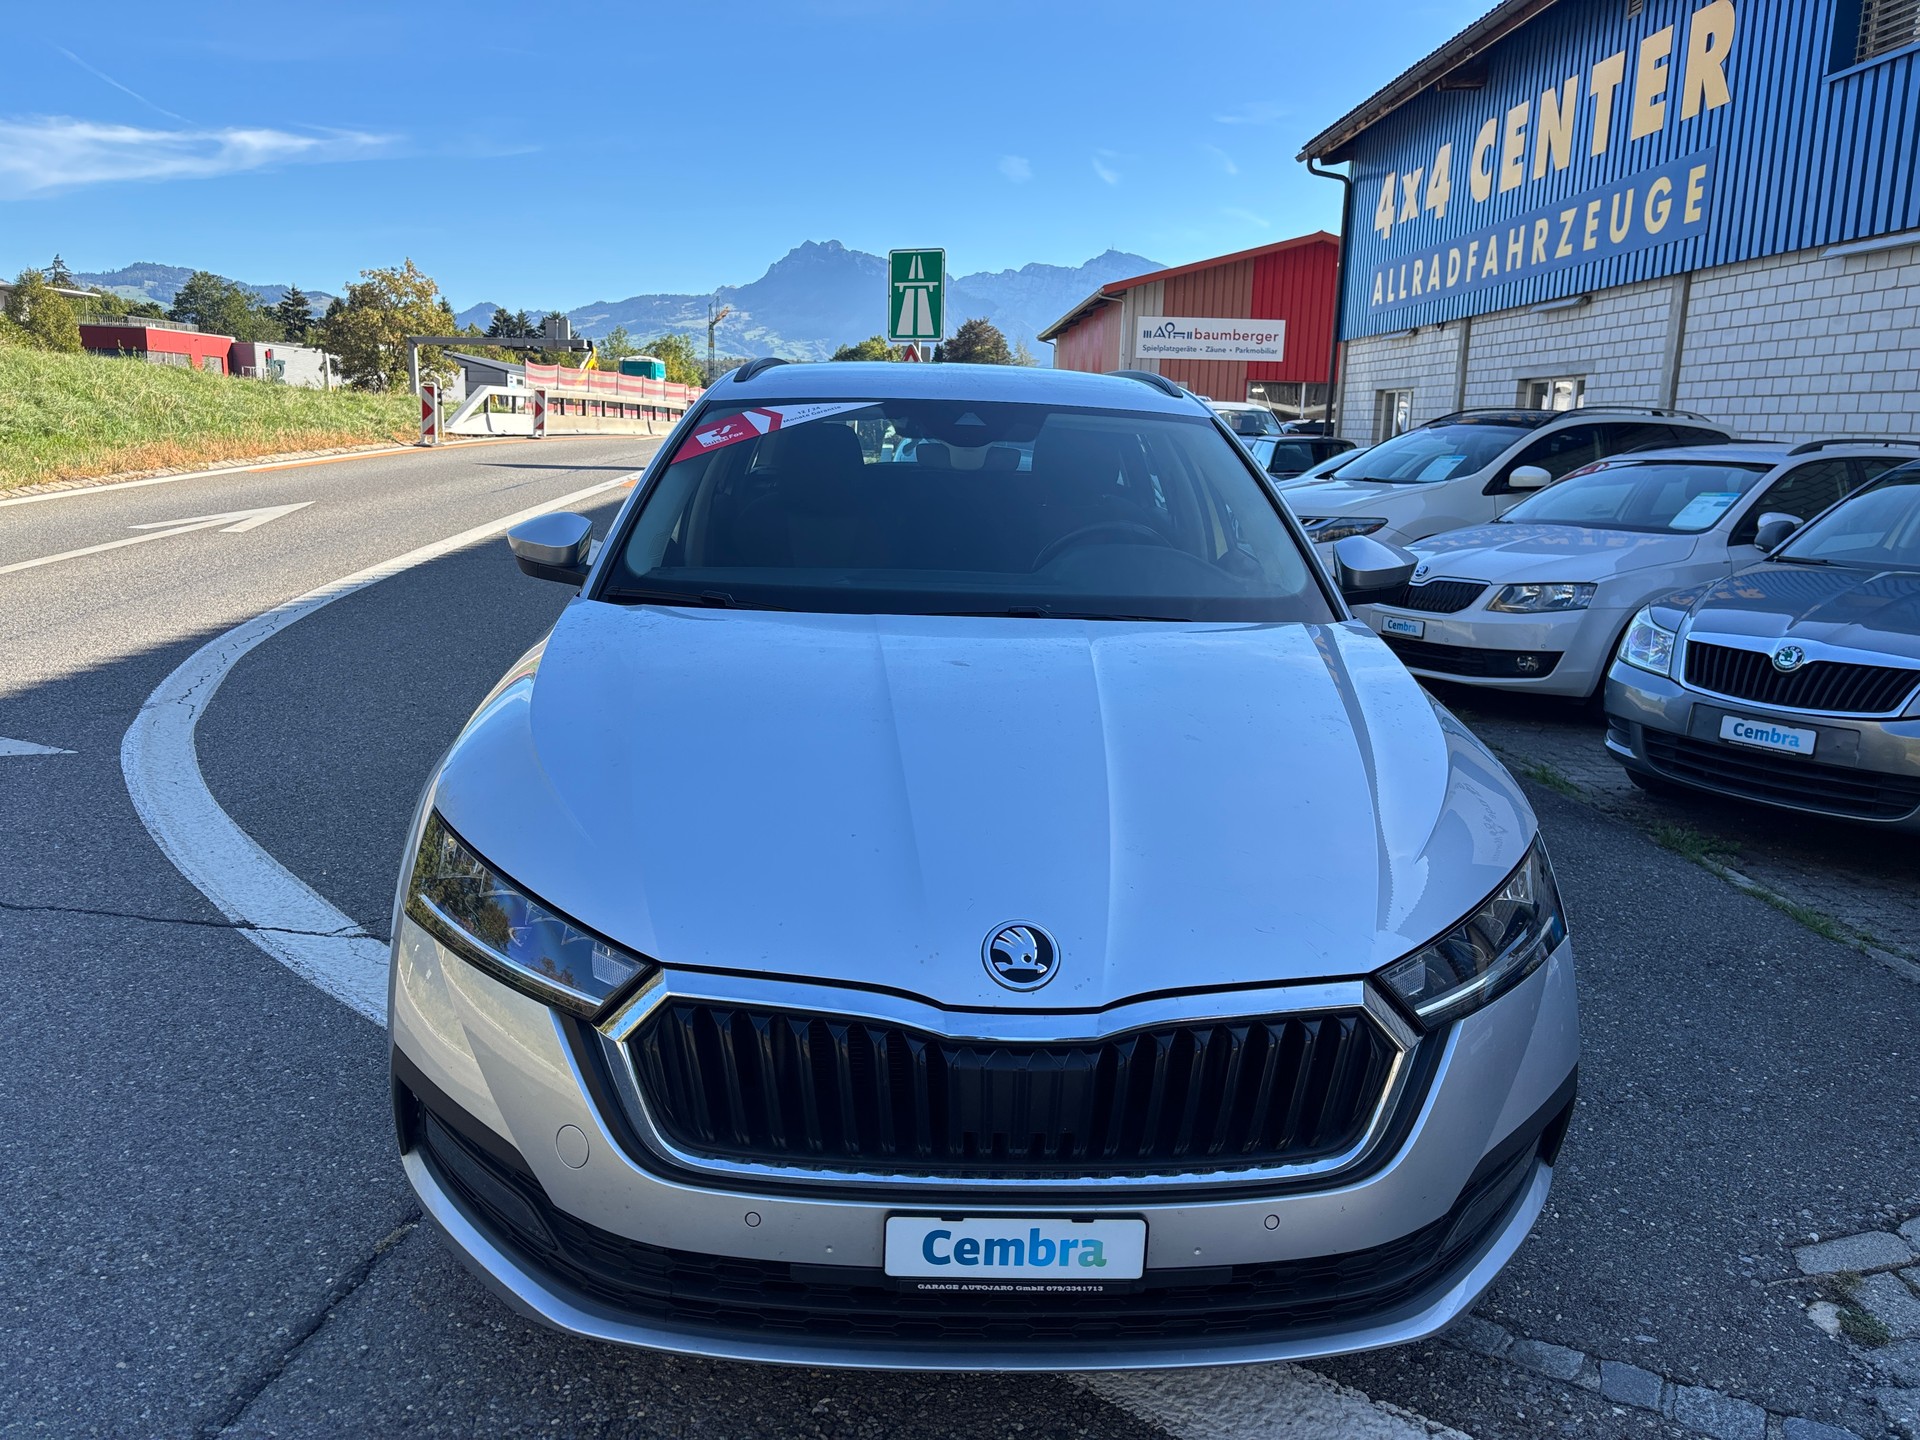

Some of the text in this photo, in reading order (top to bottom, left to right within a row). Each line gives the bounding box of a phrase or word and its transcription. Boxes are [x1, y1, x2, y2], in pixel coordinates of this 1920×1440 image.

[1374, 0, 1735, 241] 4x4 CENTER
[1372, 164, 1706, 307] ALLRADFAHRZEUGE
[1194, 328, 1279, 344] baumberger
[1142, 344, 1278, 355] Spielplatzgeräte Zäune Parkmobiliar
[1388, 619, 1417, 633] Cembra
[1733, 722, 1800, 748] Cembra
[922, 1228, 1107, 1268] Cembra
